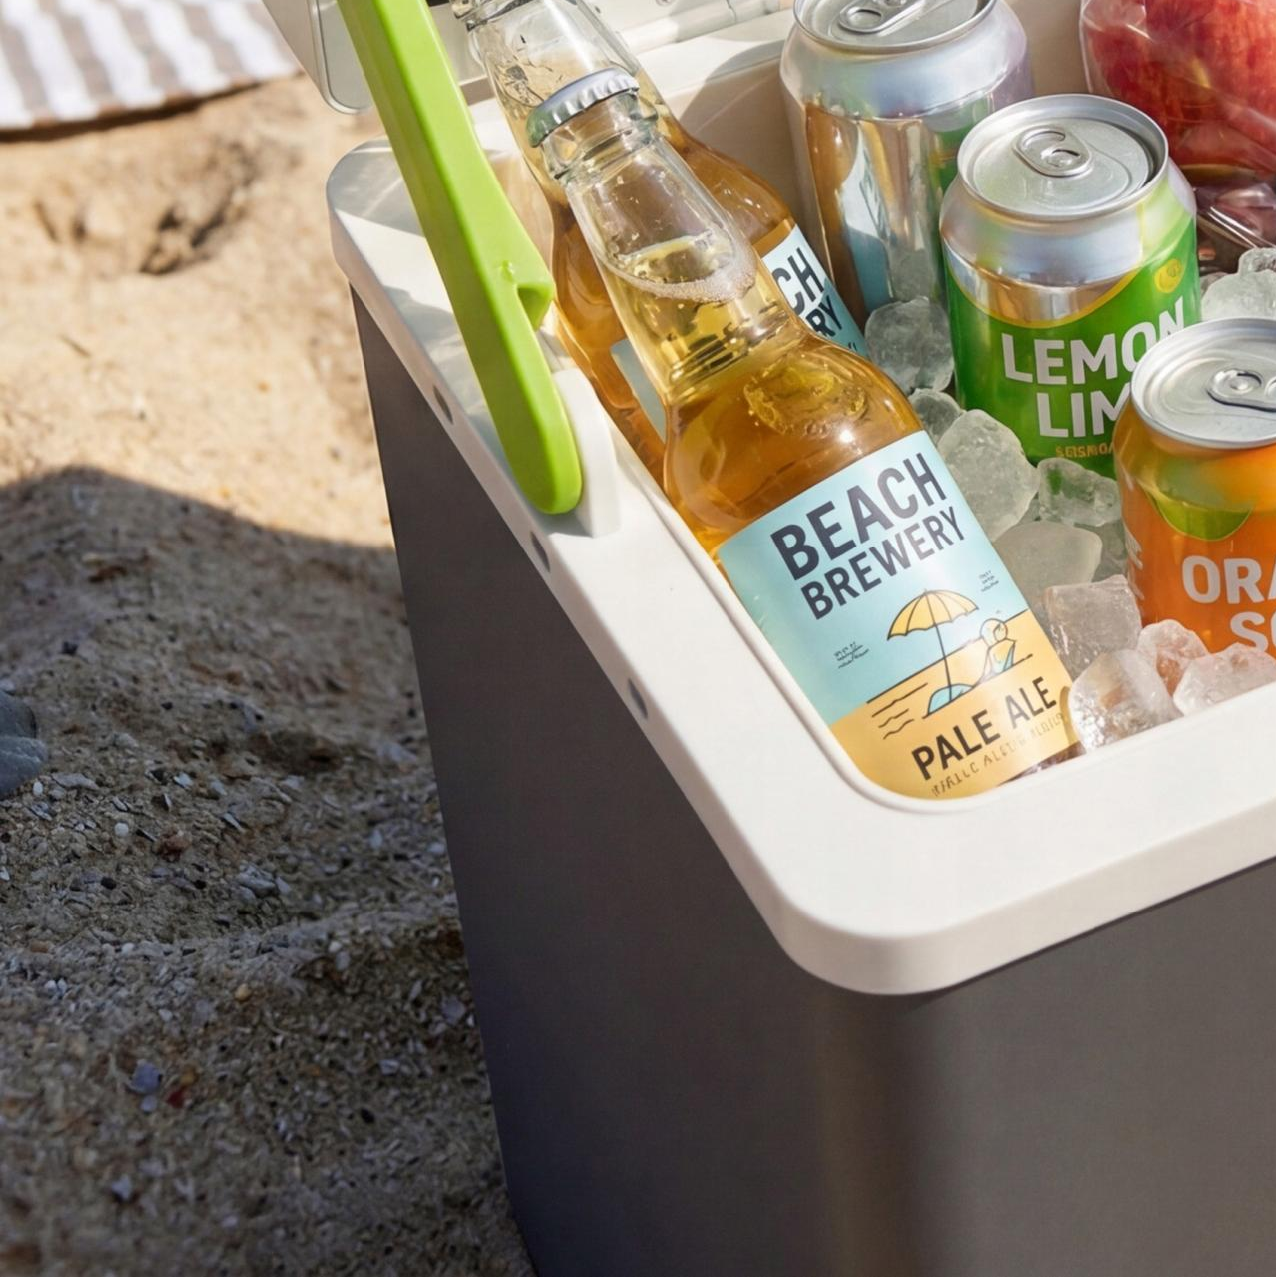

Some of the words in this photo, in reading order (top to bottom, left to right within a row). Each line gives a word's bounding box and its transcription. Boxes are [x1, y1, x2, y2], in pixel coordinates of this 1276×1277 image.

[1002, 295, 1185, 385] LEMON
[1036, 382, 1131, 438] LIM
[770, 452, 947, 581] BEACH
[800, 506, 965, 620] BREWERY
[911, 709, 1001, 781] PALE
[1004, 676, 1057, 730] ALE
